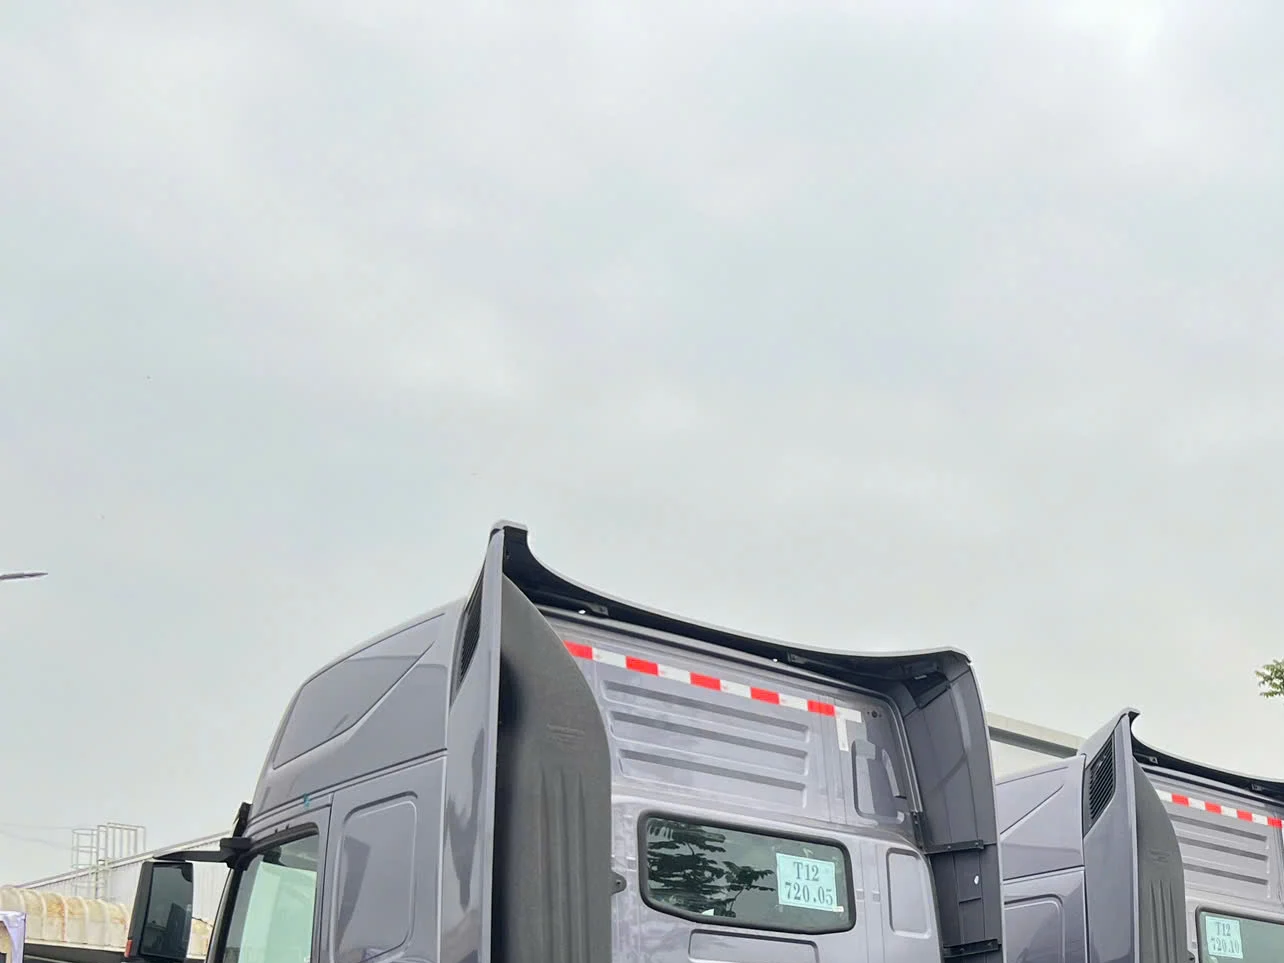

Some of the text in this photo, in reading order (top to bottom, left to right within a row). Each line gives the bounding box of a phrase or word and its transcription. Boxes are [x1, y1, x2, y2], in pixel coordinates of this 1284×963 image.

[793, 861, 820, 882] T12
[784, 881, 834, 906] 720.05
[1214, 921, 1232, 937] T12
